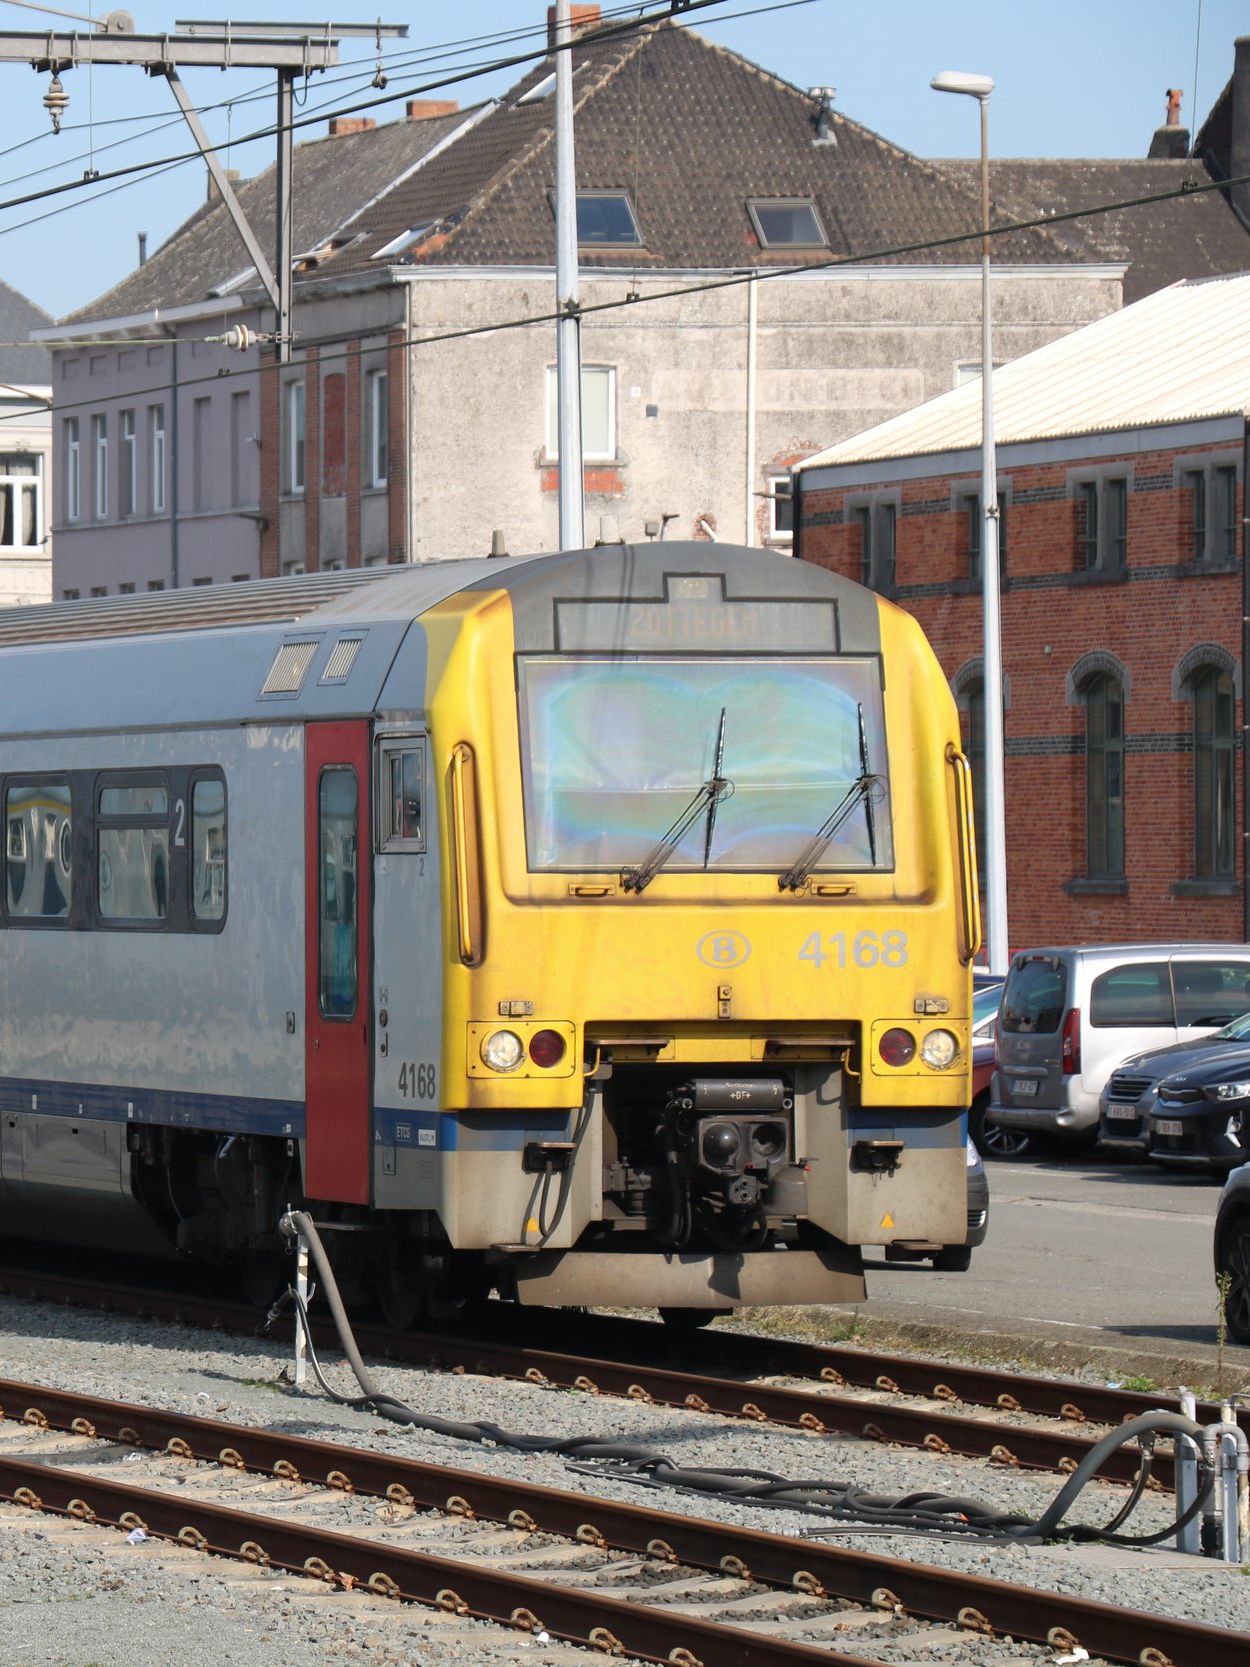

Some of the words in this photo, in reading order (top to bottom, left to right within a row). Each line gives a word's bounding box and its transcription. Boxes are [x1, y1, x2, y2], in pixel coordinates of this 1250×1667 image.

[175, 798, 185, 846] 2
[419, 857, 425, 877] 2
[797, 929, 910, 970] 4168
[398, 1061, 437, 1100] 4168
[396, 1126, 411, 1139] ETCS
